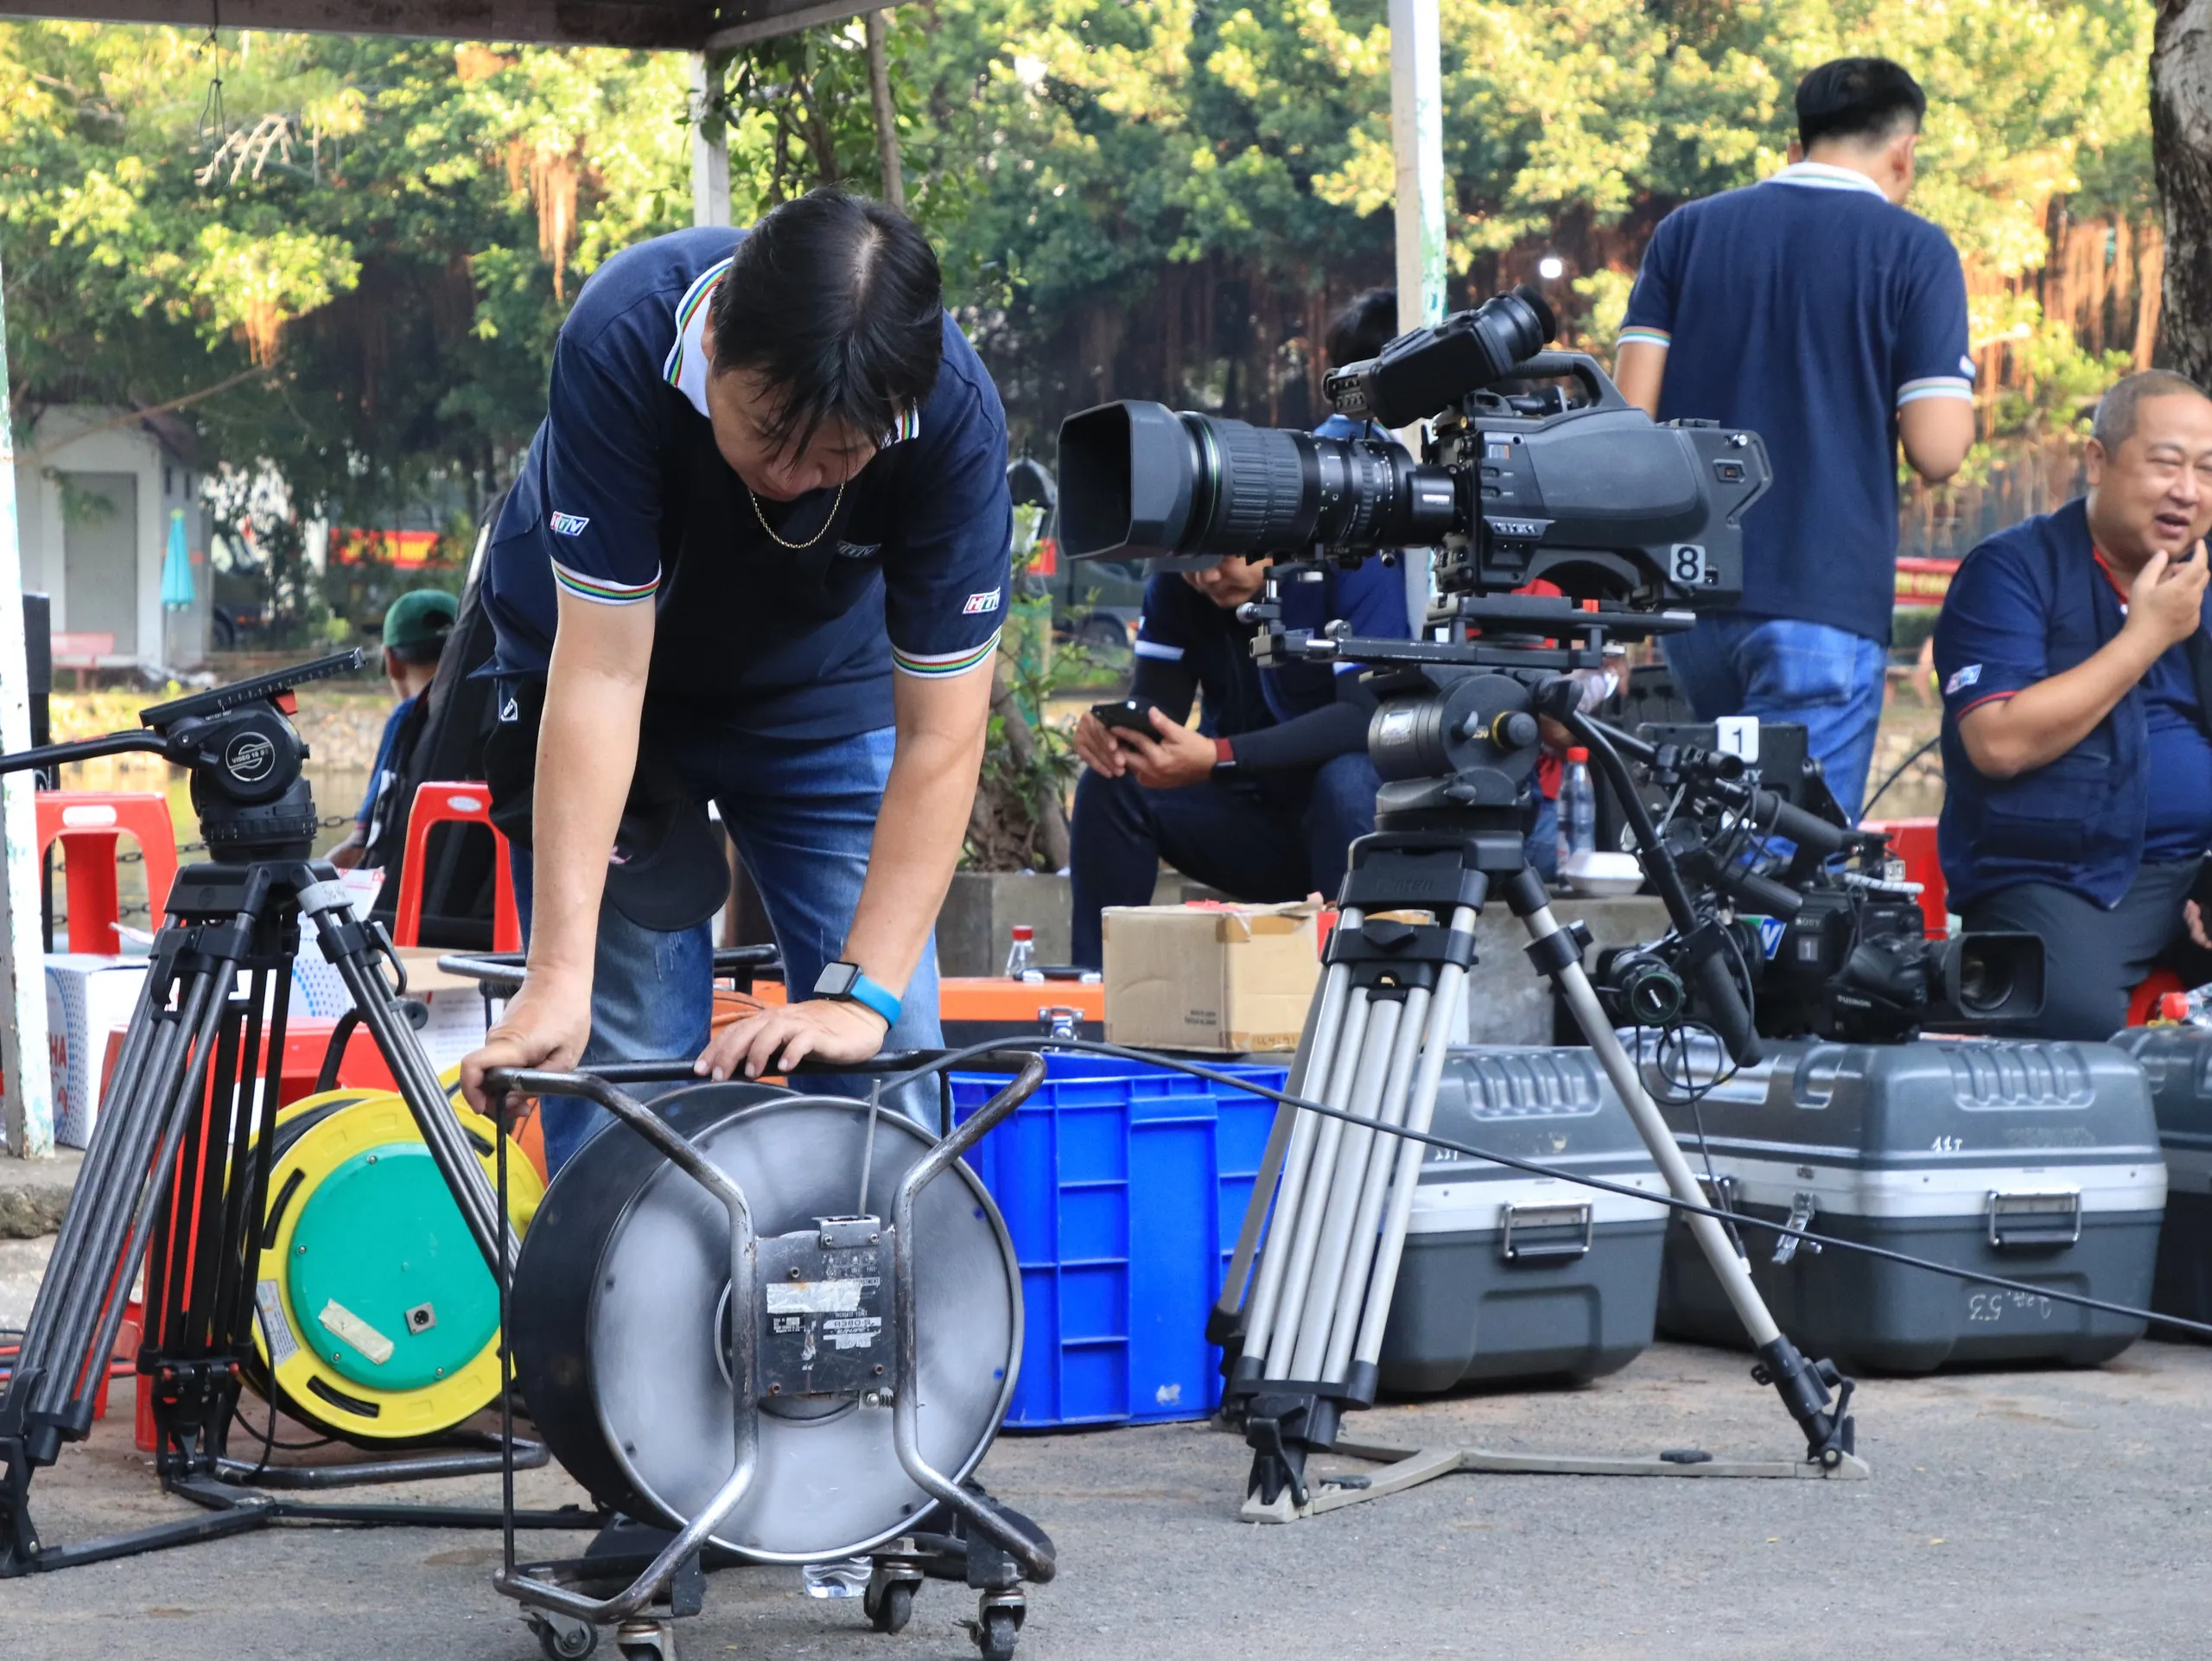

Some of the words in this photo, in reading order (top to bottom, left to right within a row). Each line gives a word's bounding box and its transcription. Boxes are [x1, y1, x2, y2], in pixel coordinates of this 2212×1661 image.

[1676, 546, 1699, 581] 8
[1732, 728, 1742, 754] 1
[1795, 917, 1821, 926] SONY
